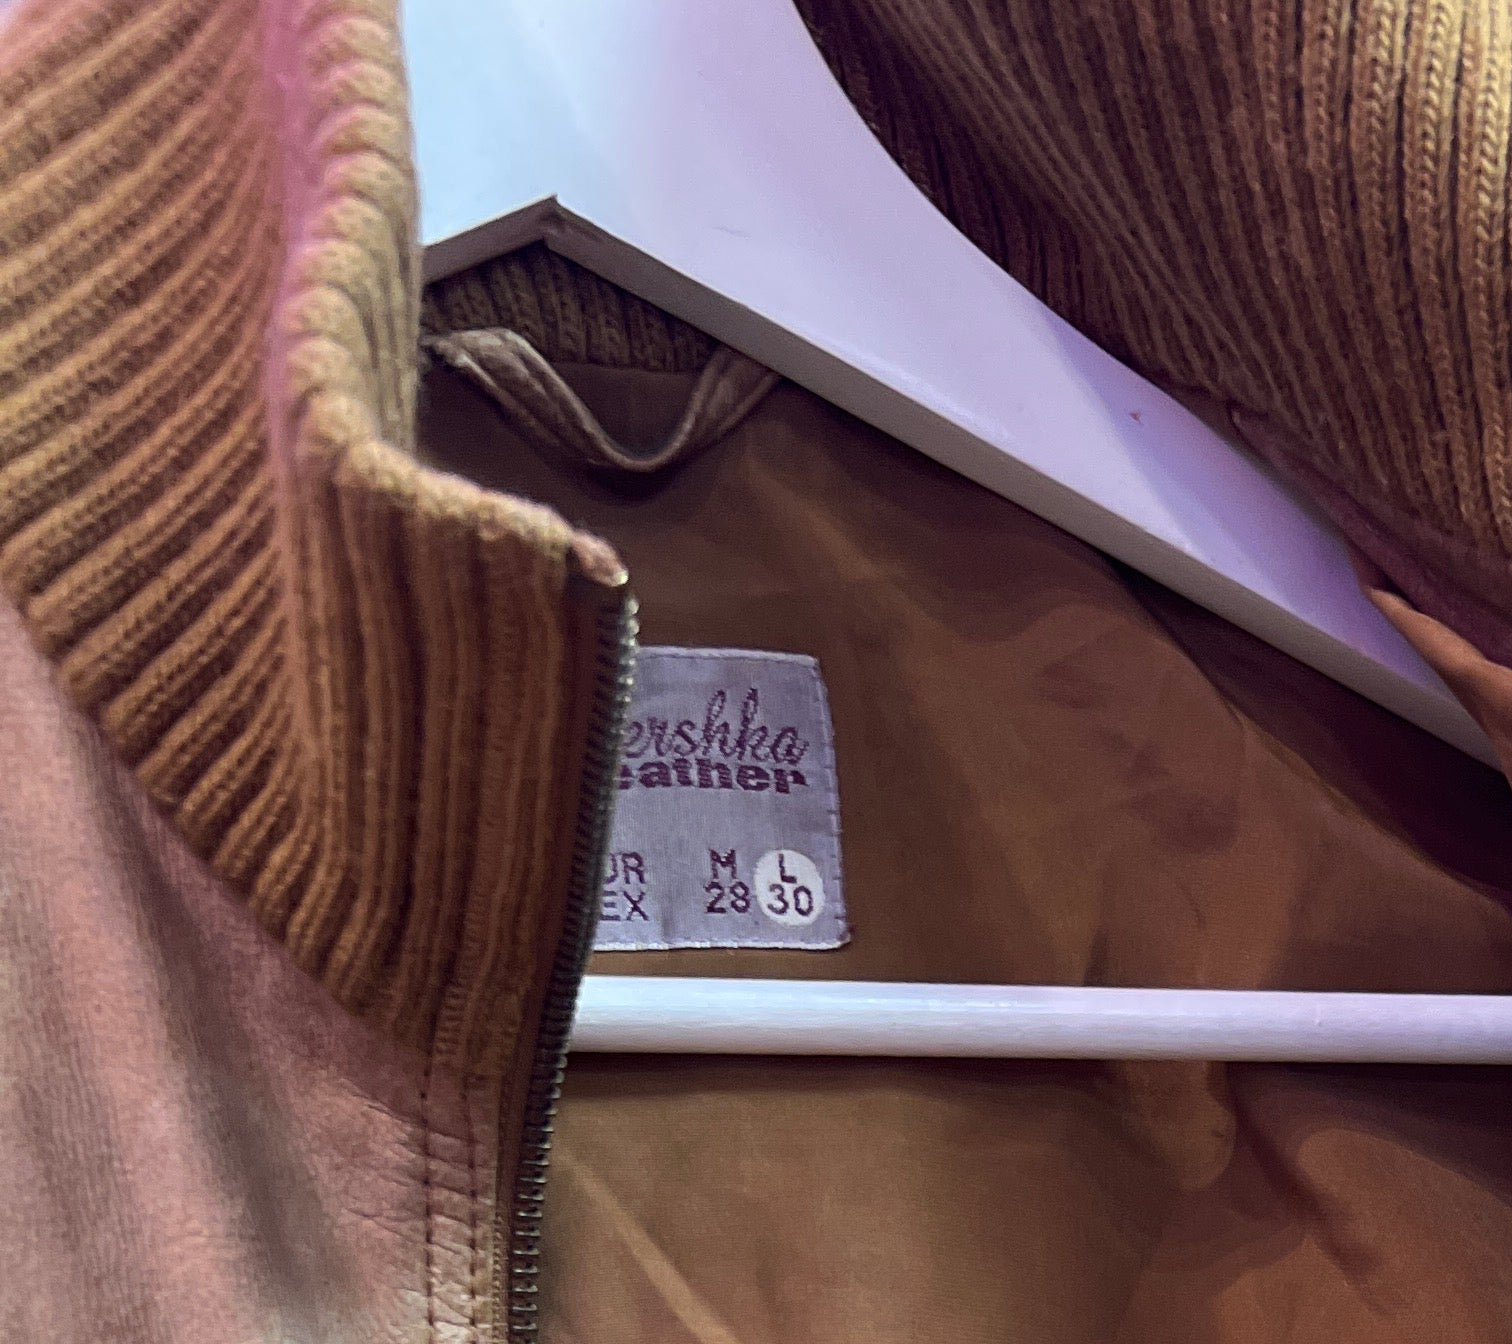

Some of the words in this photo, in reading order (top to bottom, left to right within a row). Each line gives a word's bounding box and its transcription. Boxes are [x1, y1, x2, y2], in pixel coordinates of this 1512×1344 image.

[621, 687, 809, 765] ershka
[618, 758, 809, 794] eather
[709, 847, 736, 880] M
[778, 853, 797, 884] L
[599, 890, 649, 922] EX
[705, 880, 751, 914] 28
[767, 883, 814, 917] 30
